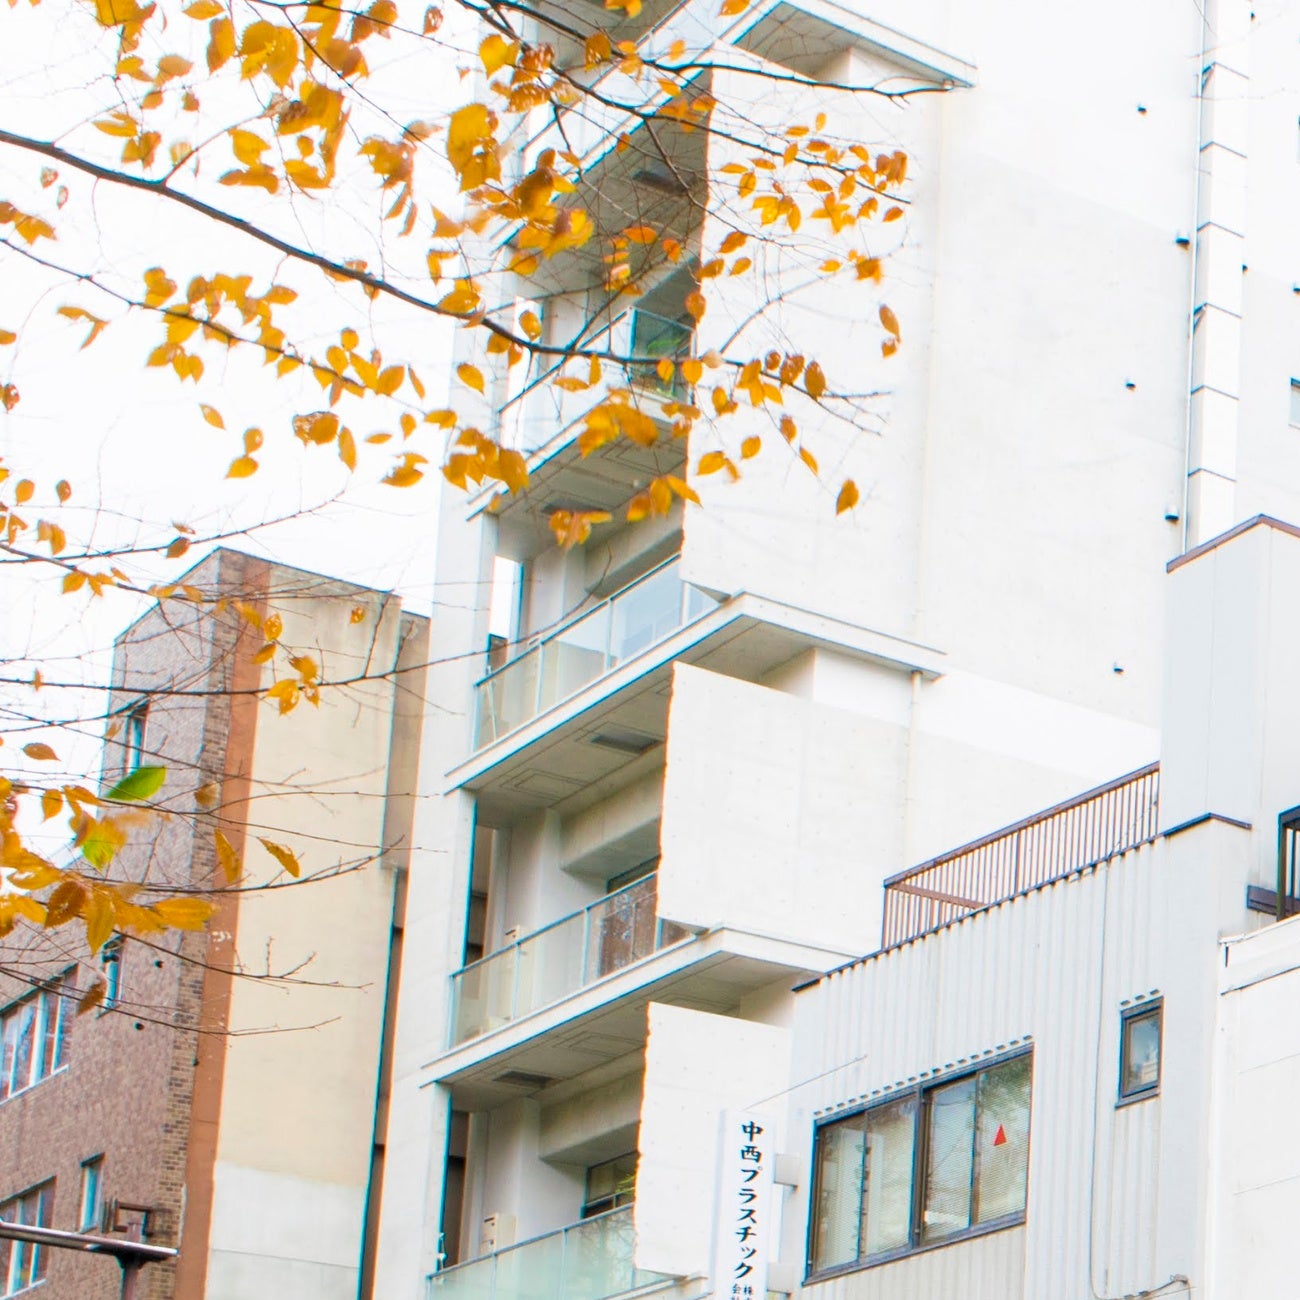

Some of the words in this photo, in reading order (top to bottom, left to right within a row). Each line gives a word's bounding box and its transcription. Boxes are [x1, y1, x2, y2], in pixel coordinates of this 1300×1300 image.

[734, 1120, 764, 1279] 中西プラスチック
